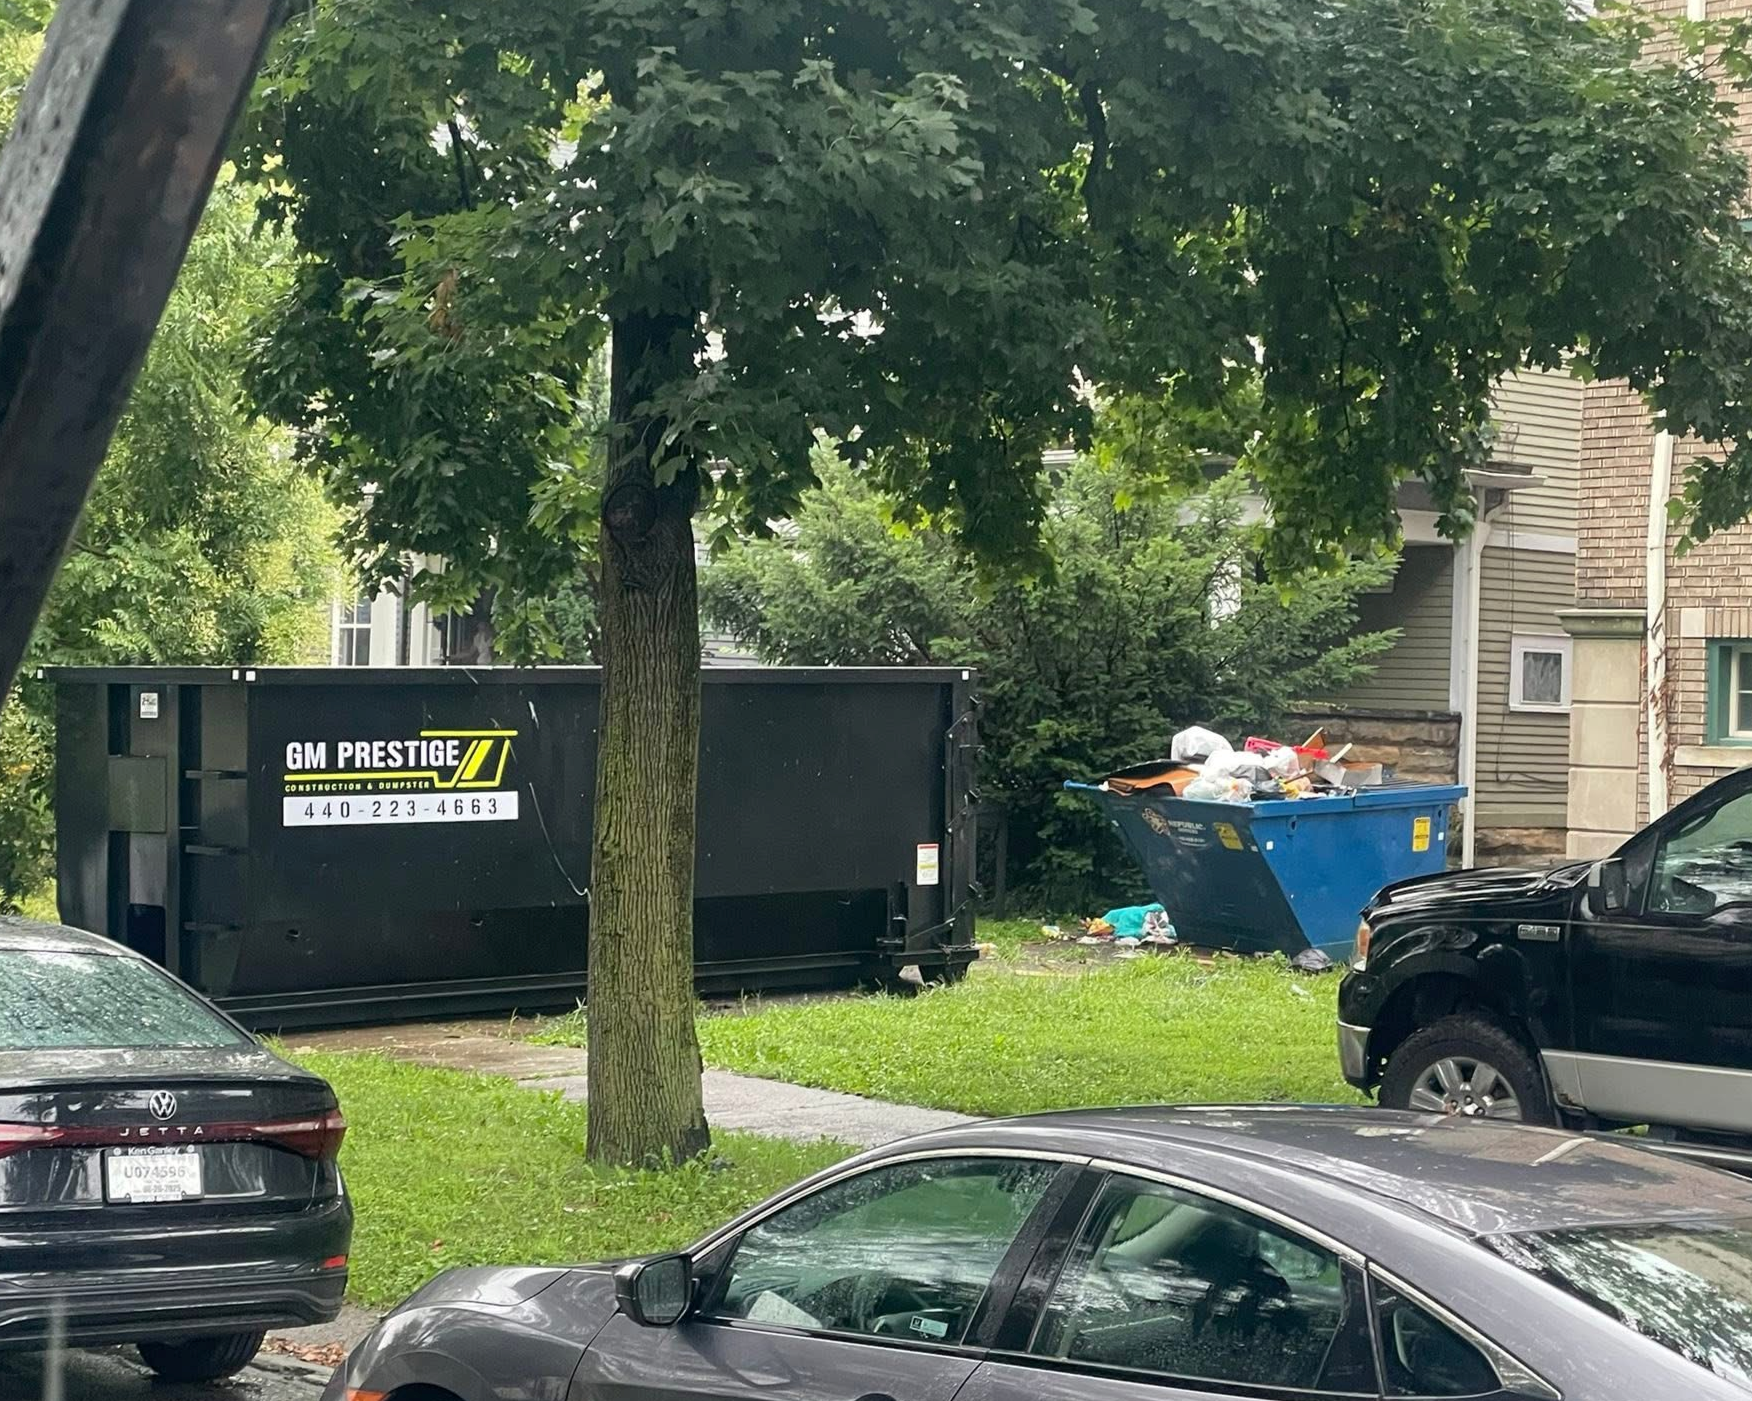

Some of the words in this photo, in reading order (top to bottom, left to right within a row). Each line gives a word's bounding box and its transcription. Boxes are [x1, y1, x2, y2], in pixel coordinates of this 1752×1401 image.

[285, 741, 327, 770] GM
[337, 740, 460, 769] PRESTIGE
[284, 782, 361, 793] CONSTRUCTION
[367, 782, 373, 791] &
[379, 781, 430, 790] DUMPSTER
[304, 798, 497, 819] 440-223-4663
[120, 1126, 203, 1137] JETTA
